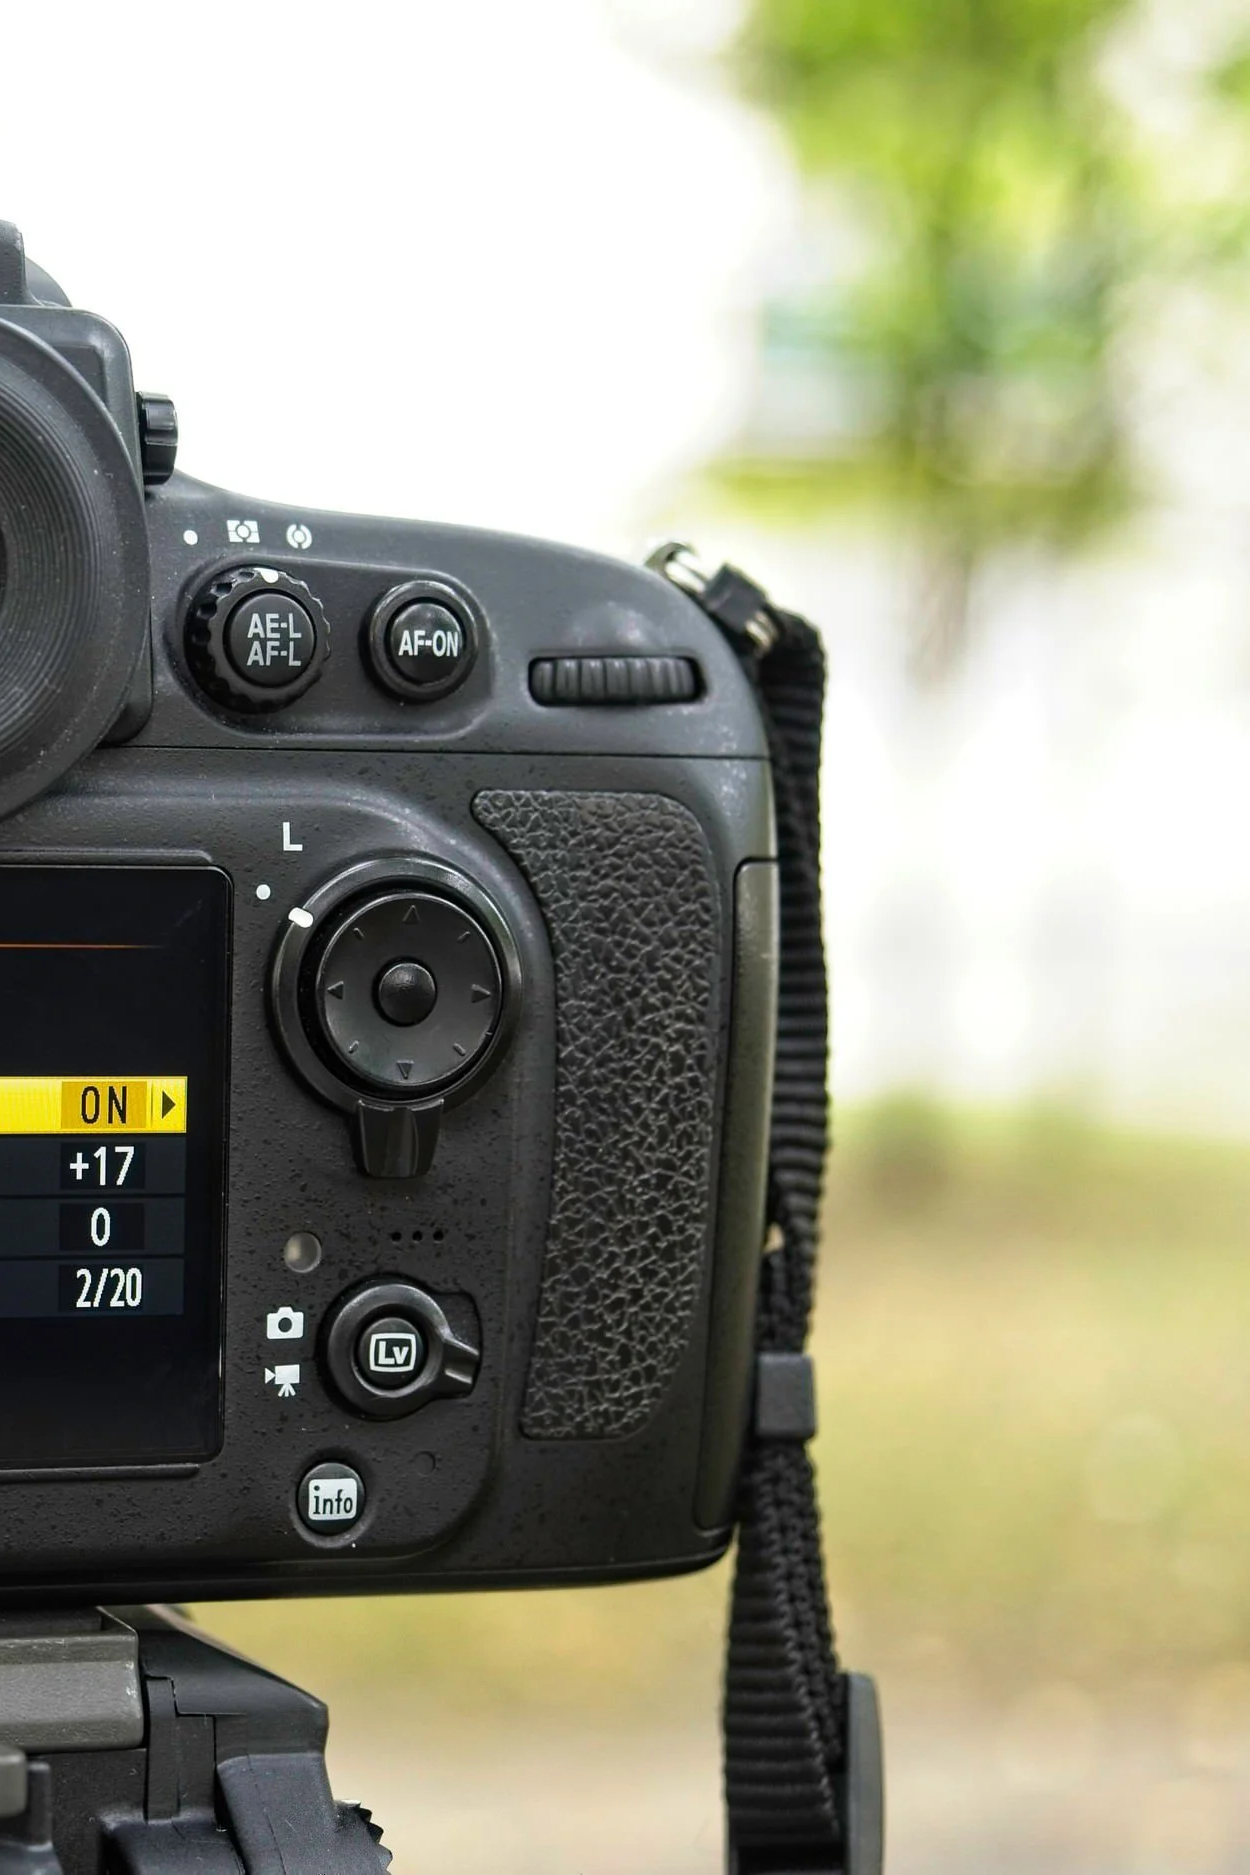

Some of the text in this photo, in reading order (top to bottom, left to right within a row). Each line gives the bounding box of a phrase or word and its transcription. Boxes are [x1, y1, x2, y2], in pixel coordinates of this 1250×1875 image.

[247, 613, 302, 640] AE-L
[246, 640, 302, 667] AF-L
[398, 628, 459, 658] AF-ON
[282, 821, 303, 852] L
[69, 1145, 136, 1186] +17
[90, 1206, 111, 1247] 0
[75, 1267, 143, 1308] 2/20
[377, 1340, 409, 1365] Lv
[312, 1484, 354, 1516] info
